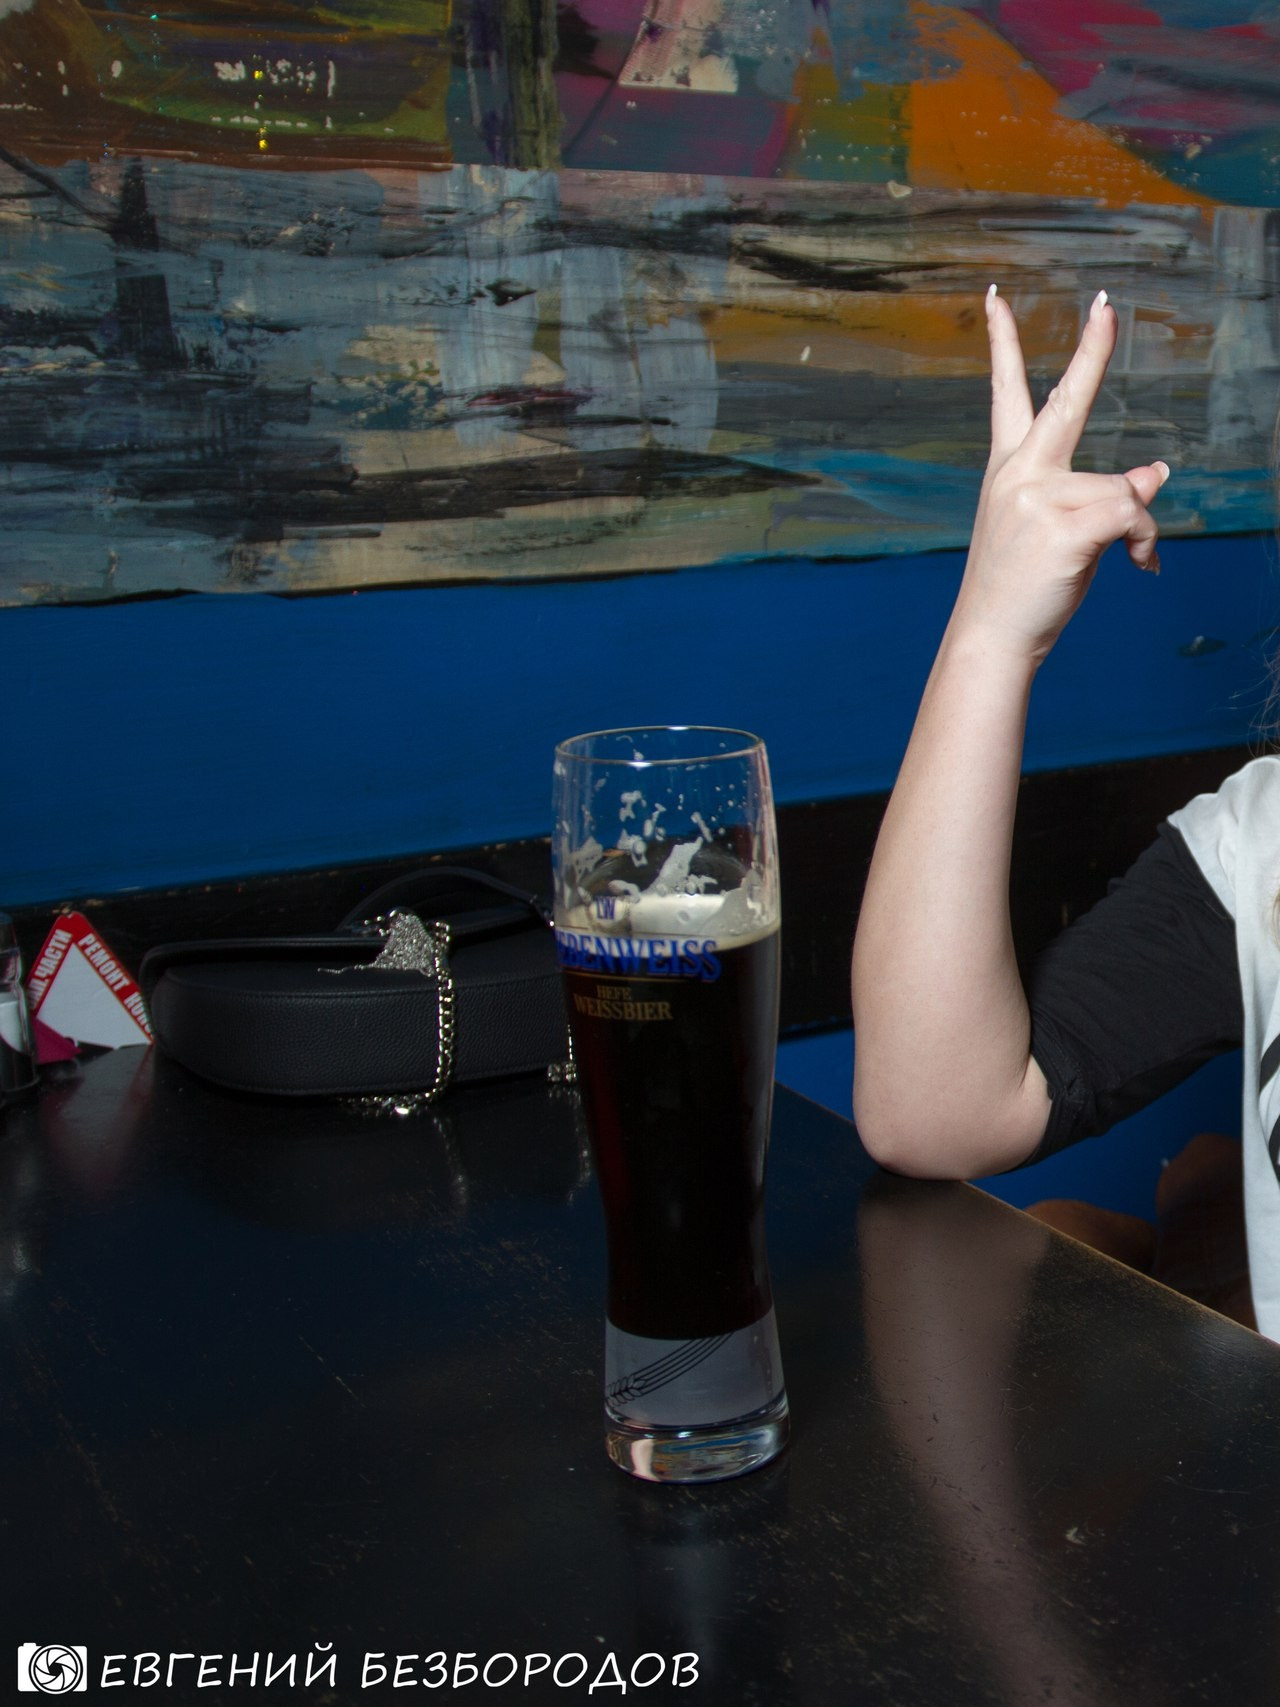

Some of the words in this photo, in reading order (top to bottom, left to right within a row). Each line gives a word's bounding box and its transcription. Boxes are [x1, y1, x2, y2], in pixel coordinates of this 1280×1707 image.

[31, 928, 73, 1009] АП.ЧАСТИ
[78, 932, 130, 992] РЕМОНТ
[573, 992, 673, 1021] WEISSBIER
[596, 984, 633, 1000] HEFE
